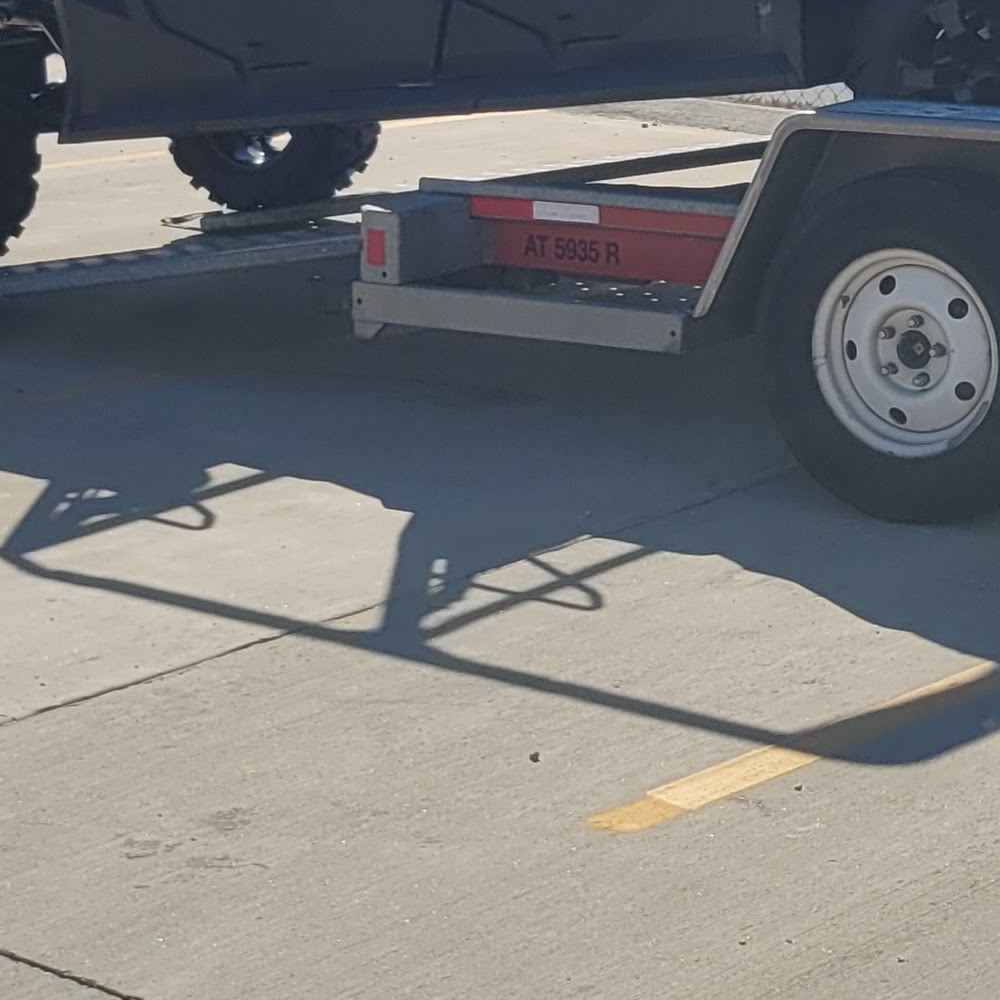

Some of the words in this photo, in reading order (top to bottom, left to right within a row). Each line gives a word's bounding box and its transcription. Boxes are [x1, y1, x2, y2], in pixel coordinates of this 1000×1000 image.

[524, 235, 547, 257] AT
[554, 237, 599, 263] 5935
[605, 242, 620, 264] R
